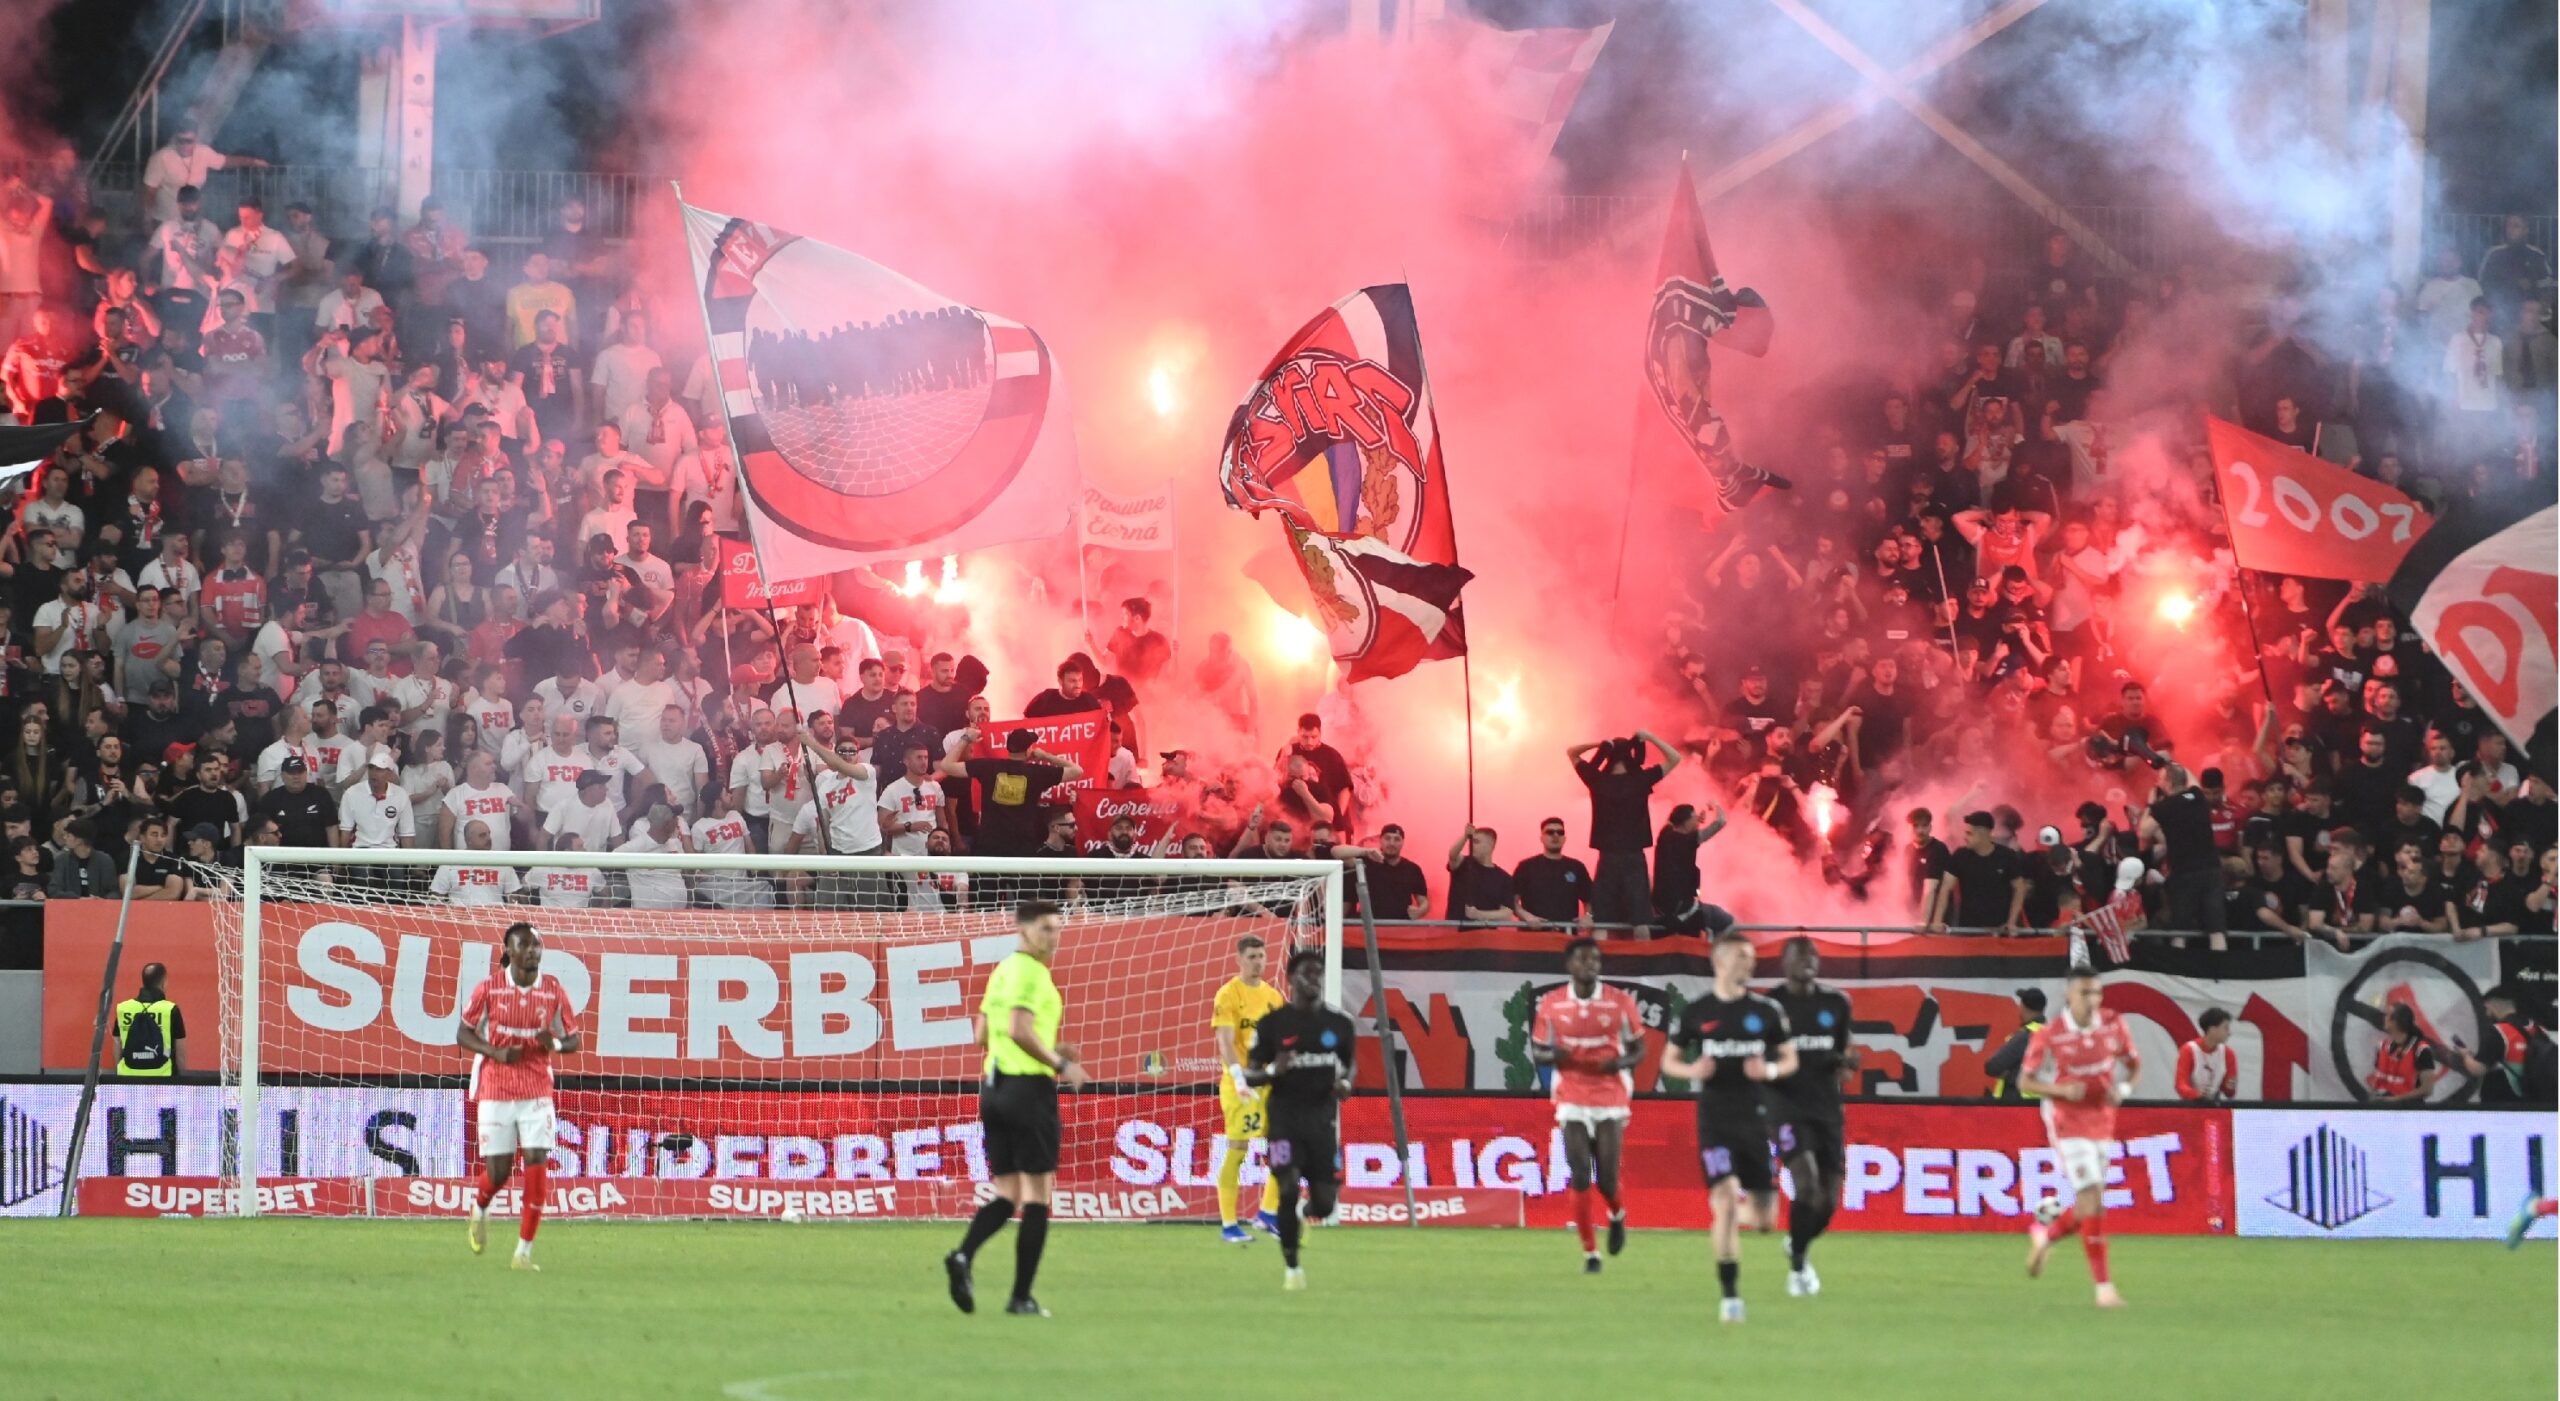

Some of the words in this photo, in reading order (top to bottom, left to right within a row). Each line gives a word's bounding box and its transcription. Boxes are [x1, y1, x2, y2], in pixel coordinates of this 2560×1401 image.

[2228, 461, 2416, 544] 2007
[464, 796, 506, 817] FCH
[705, 820, 745, 846] FCH
[457, 869, 499, 886] FCH
[547, 873, 588, 892] FCH
[1242, 1111, 1262, 1134] 32
[707, 1184, 896, 1215] SUPERBET
[973, 1181, 1187, 1217] SERLIGA
